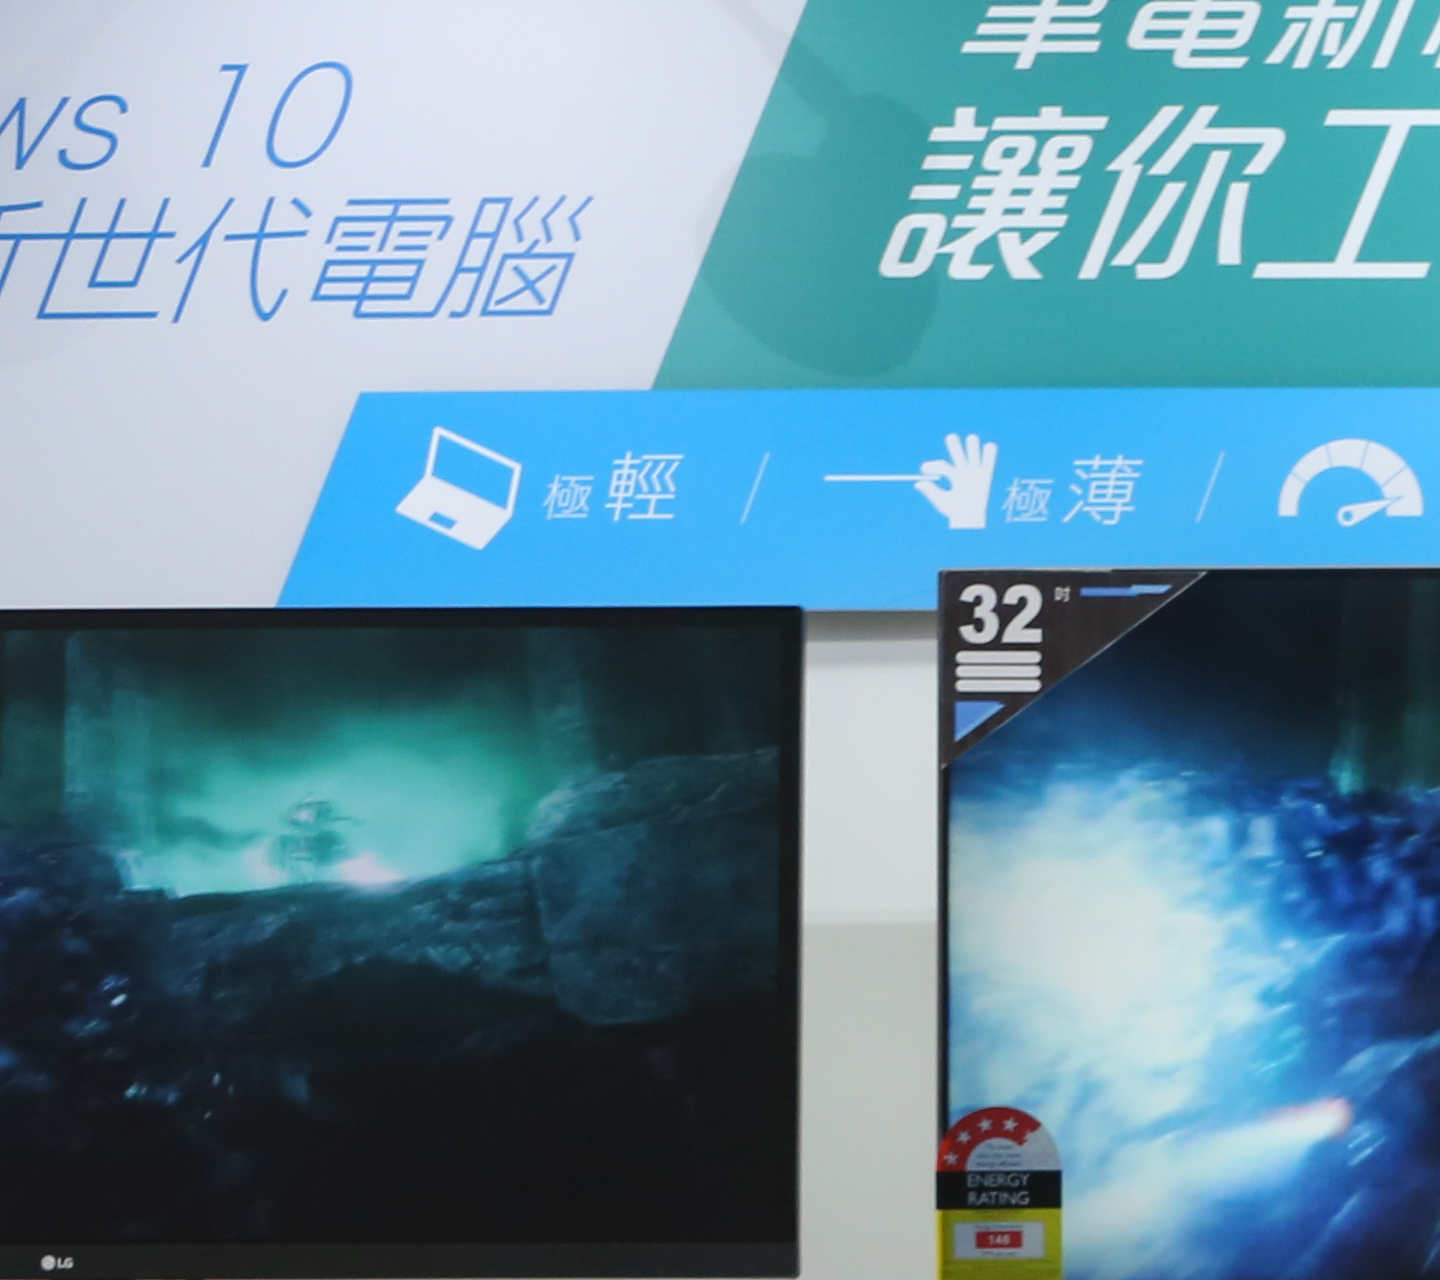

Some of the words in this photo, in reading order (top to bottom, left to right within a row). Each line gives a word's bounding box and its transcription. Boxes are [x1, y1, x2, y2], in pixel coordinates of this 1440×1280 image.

[197, 61, 353, 171] 10
[542, 450, 684, 526] 極輕
[1003, 453, 1143, 527] 極薄
[958, 583, 1044, 645] 32
[966, 1172, 1030, 1188] ENERGY
[966, 1191, 1031, 1206] RATING
